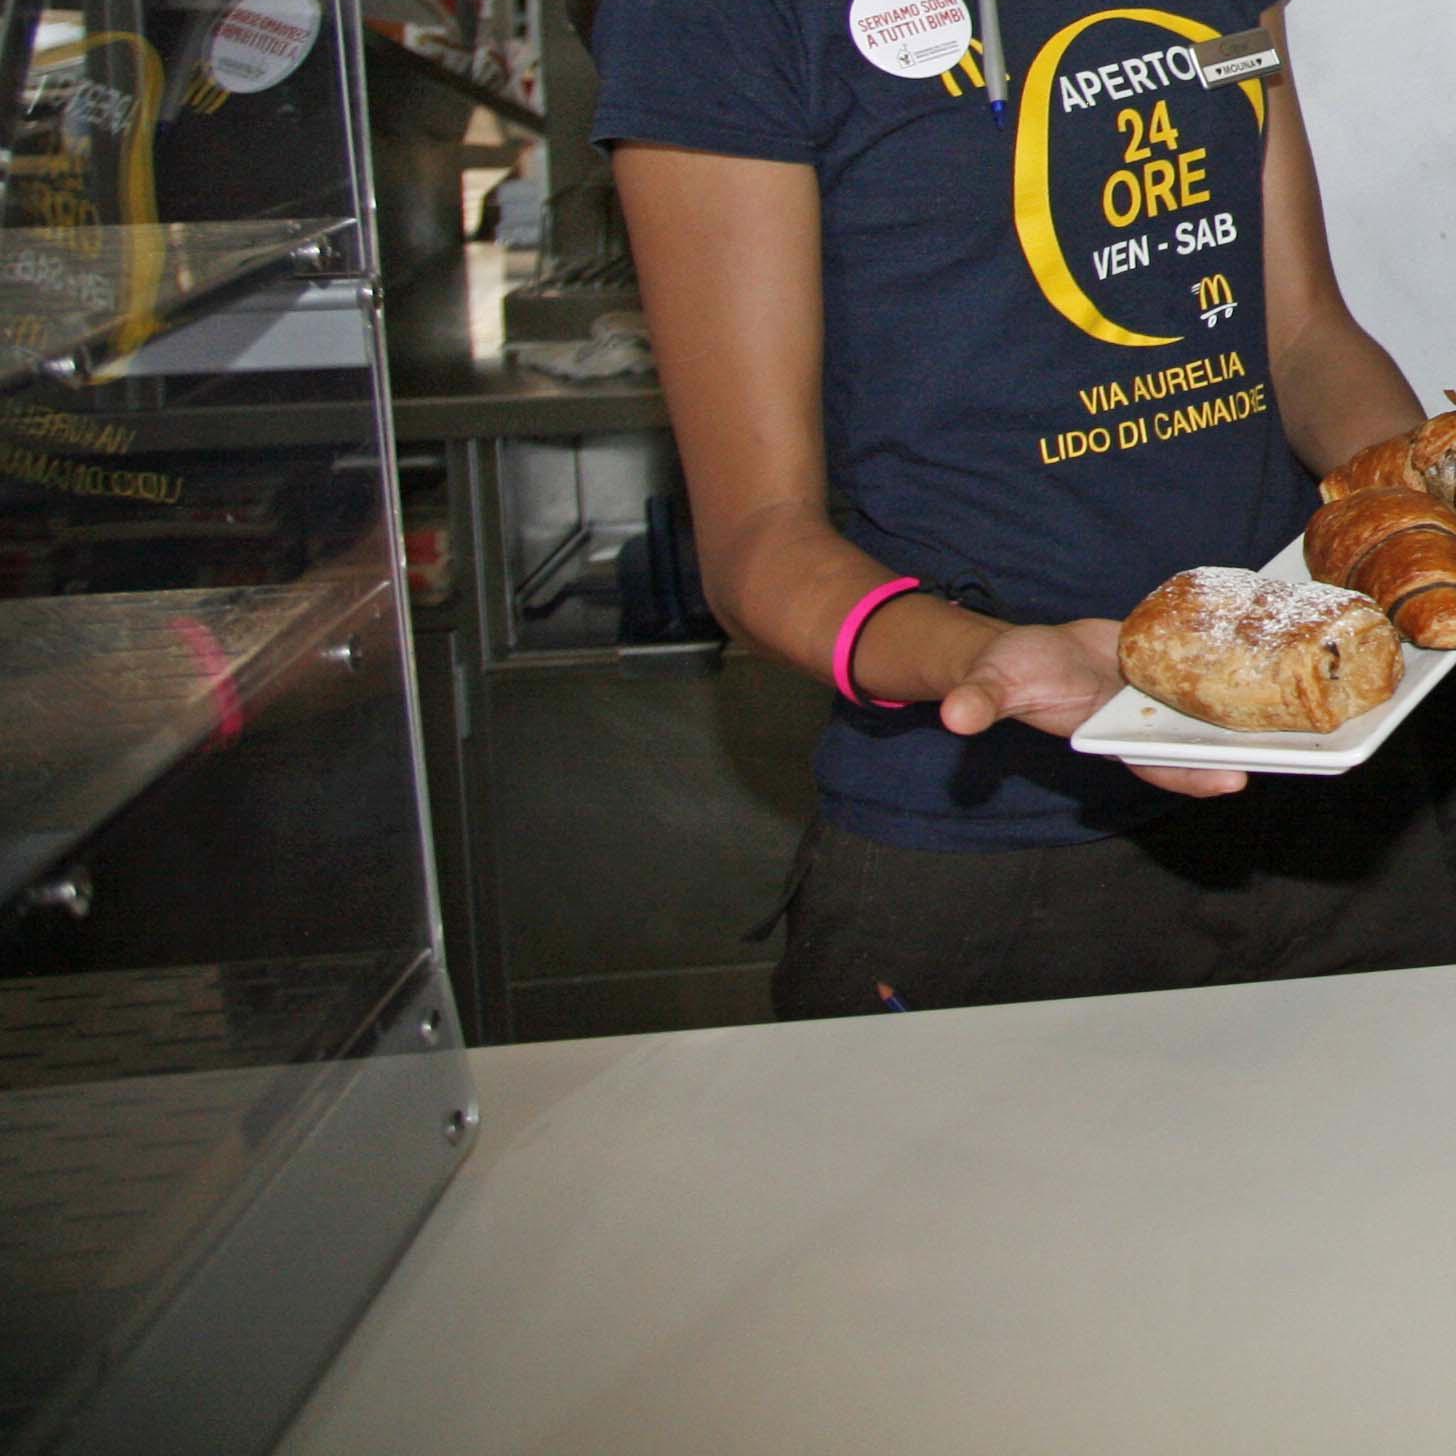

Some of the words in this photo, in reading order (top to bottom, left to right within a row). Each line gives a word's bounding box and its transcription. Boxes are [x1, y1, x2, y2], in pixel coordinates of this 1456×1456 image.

[857, 2, 921, 33] SERVIAMO
[867, 33, 879, 49] A
[878, 21, 920, 45] TUTTI
[926, 7, 966, 31] BIMBI
[1058, 44, 1198, 114] APERTO
[1116, 99, 1180, 166] 24
[1102, 146, 1211, 230] ORE
[1092, 234, 1151, 281] VEN
[1174, 211, 1239, 257] SAB
[1079, 381, 1130, 417] VIA
[1133, 351, 1246, 403] AURELIA
[1039, 426, 1112, 466] LIDO
[1119, 417, 1148, 449] DI
